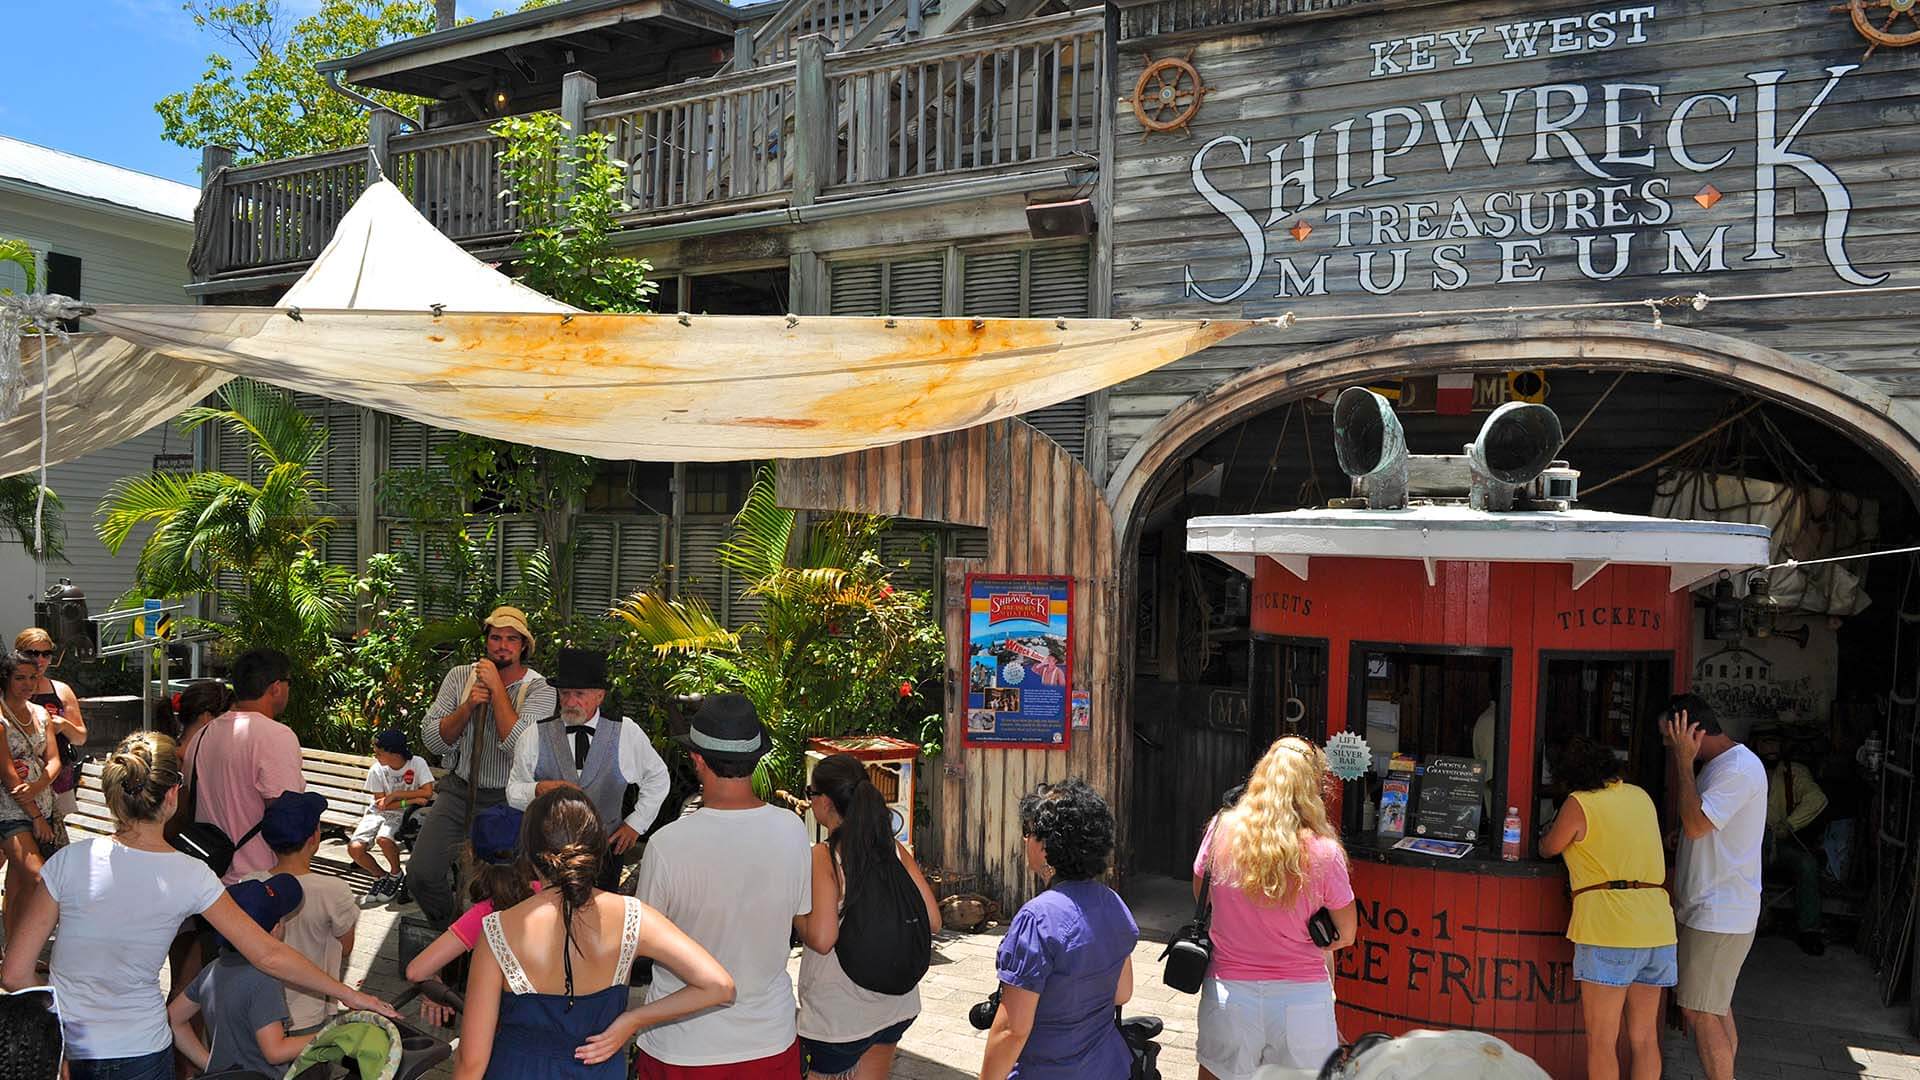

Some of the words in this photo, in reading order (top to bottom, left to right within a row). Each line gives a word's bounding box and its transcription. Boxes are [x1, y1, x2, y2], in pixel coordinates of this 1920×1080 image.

[1369, 27, 1485, 77] KEY
[1495, 6, 1655, 59] WEST
[1184, 63, 1889, 303] SHIPWRECK
[1325, 178, 1671, 248] TREASURES
[1273, 224, 1733, 299] MUSEUM
[991, 596, 1047, 617] SHIPWRECK
[1557, 607, 1661, 631] TICKETS
[1333, 750, 1362, 758] SILVER
[1339, 736, 1359, 744] LIFT
[1432, 910, 1452, 940] 1
[1335, 939, 1390, 985] EE
